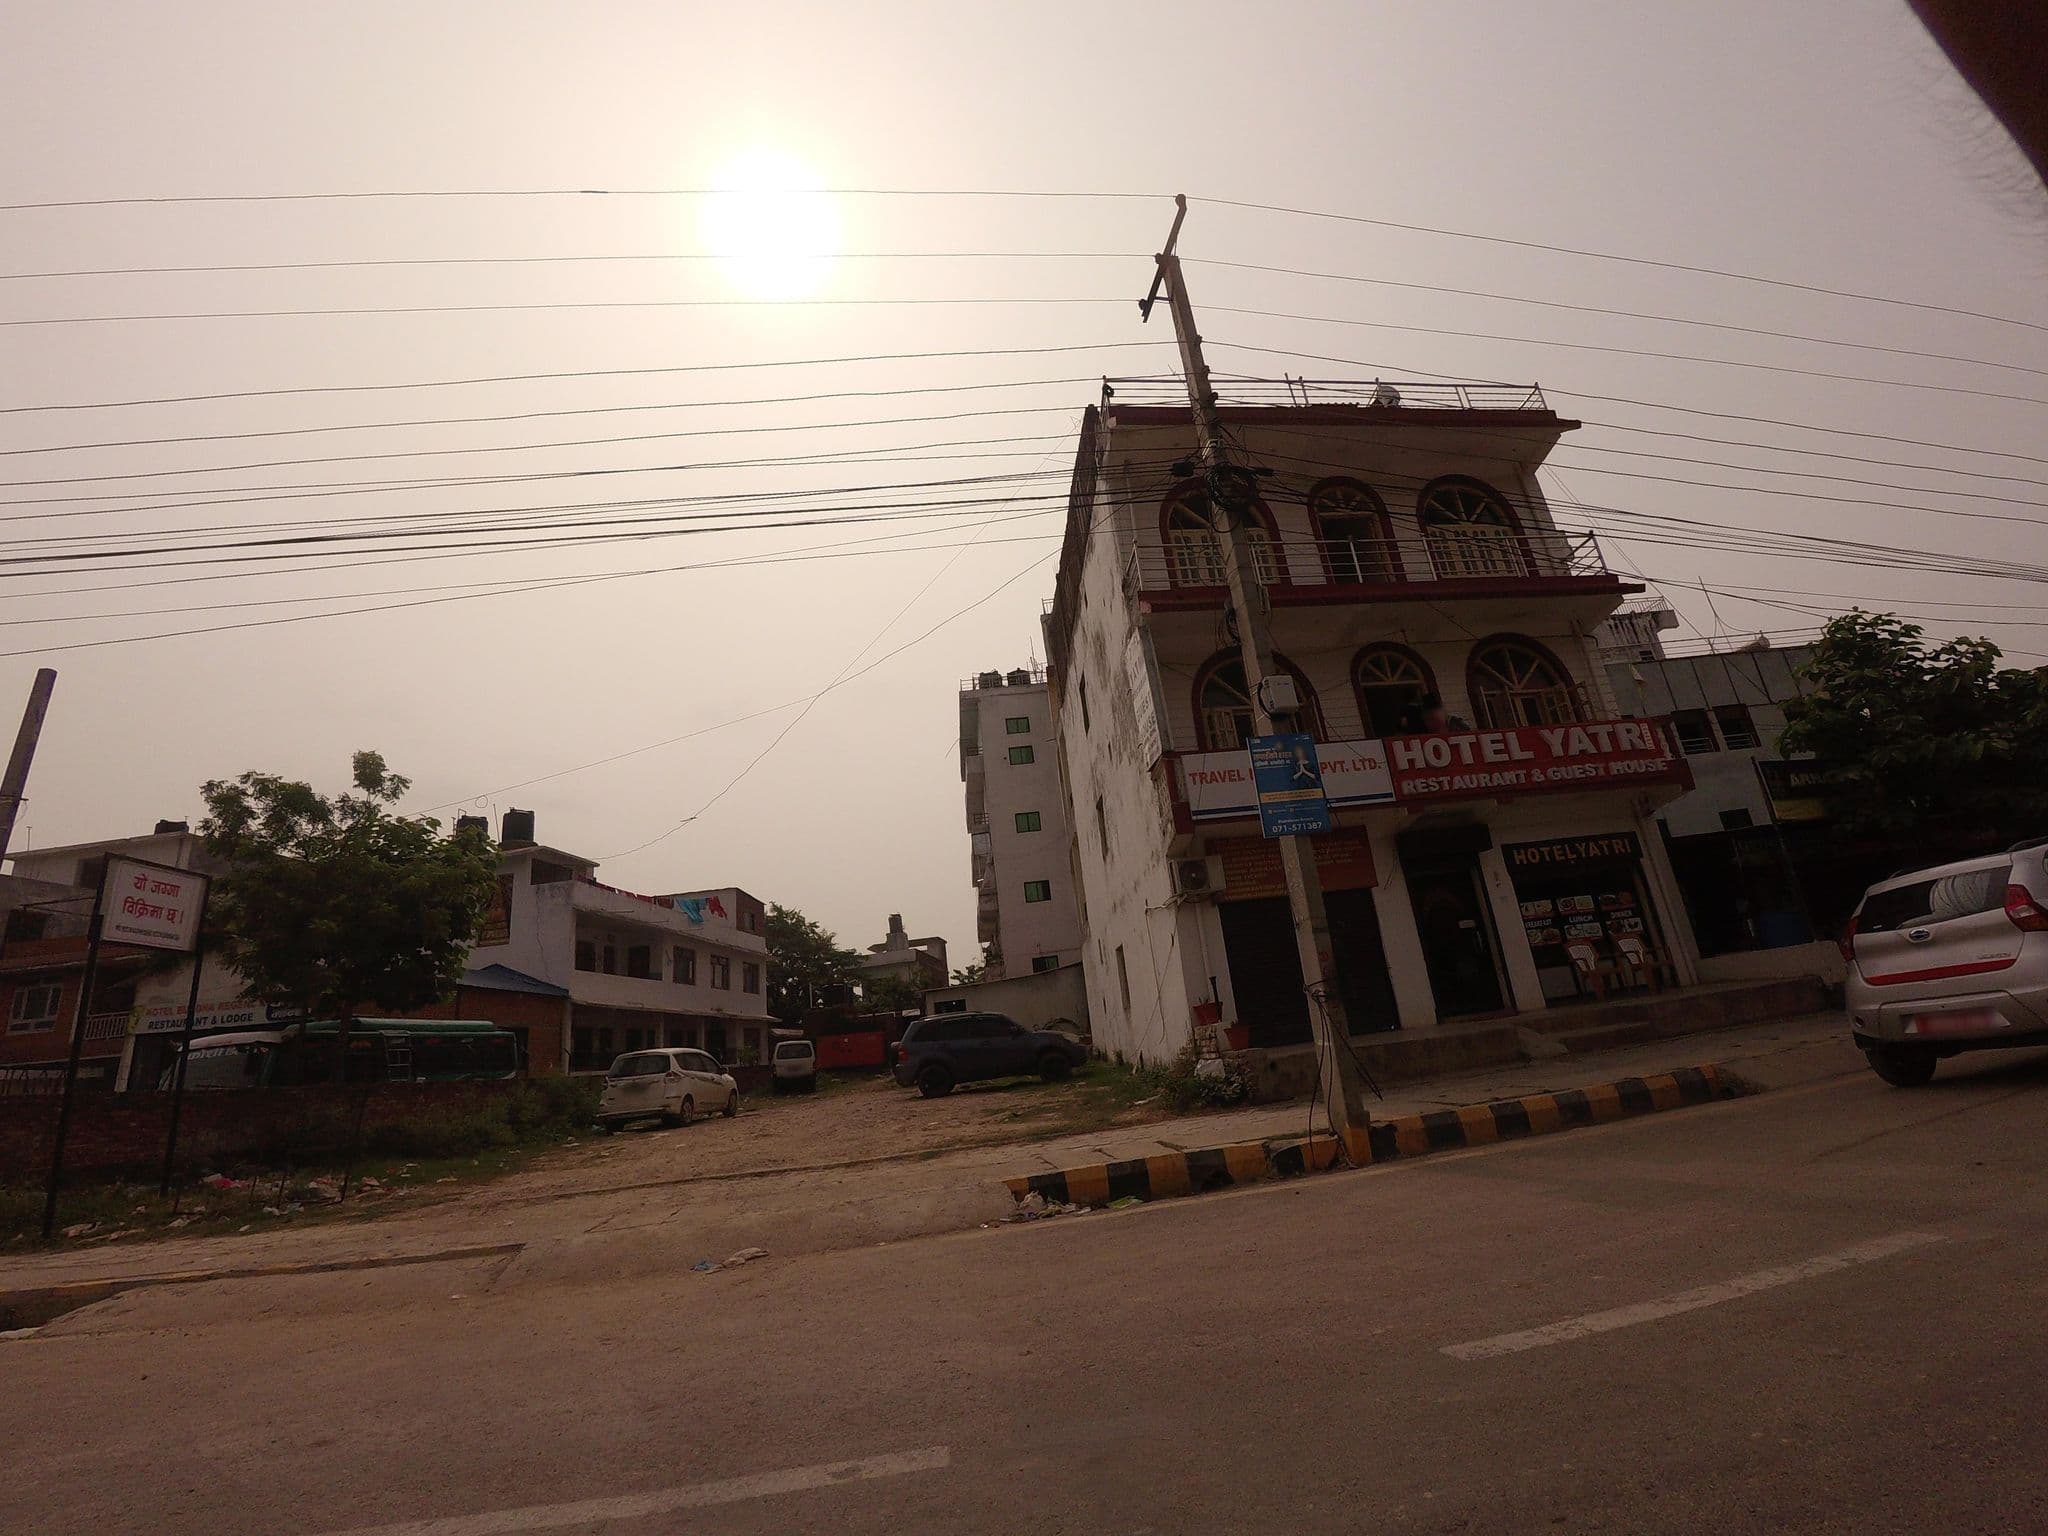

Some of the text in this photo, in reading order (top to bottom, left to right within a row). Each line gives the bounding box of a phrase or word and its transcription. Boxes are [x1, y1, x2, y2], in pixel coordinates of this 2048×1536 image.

[1391, 722, 1655, 770] HOTEL YATRI
[1188, 769, 1245, 785] TRAVEL
[1320, 761, 1349, 774] PVT.
[1353, 757, 1381, 771] LTD.
[1401, 759, 1668, 795] RESTAURANT & GUEST HOUSE
[134, 874, 147, 891] यो
[148, 1016, 209, 1030] RESTAURNT
[220, 1013, 254, 1024] LODGE
